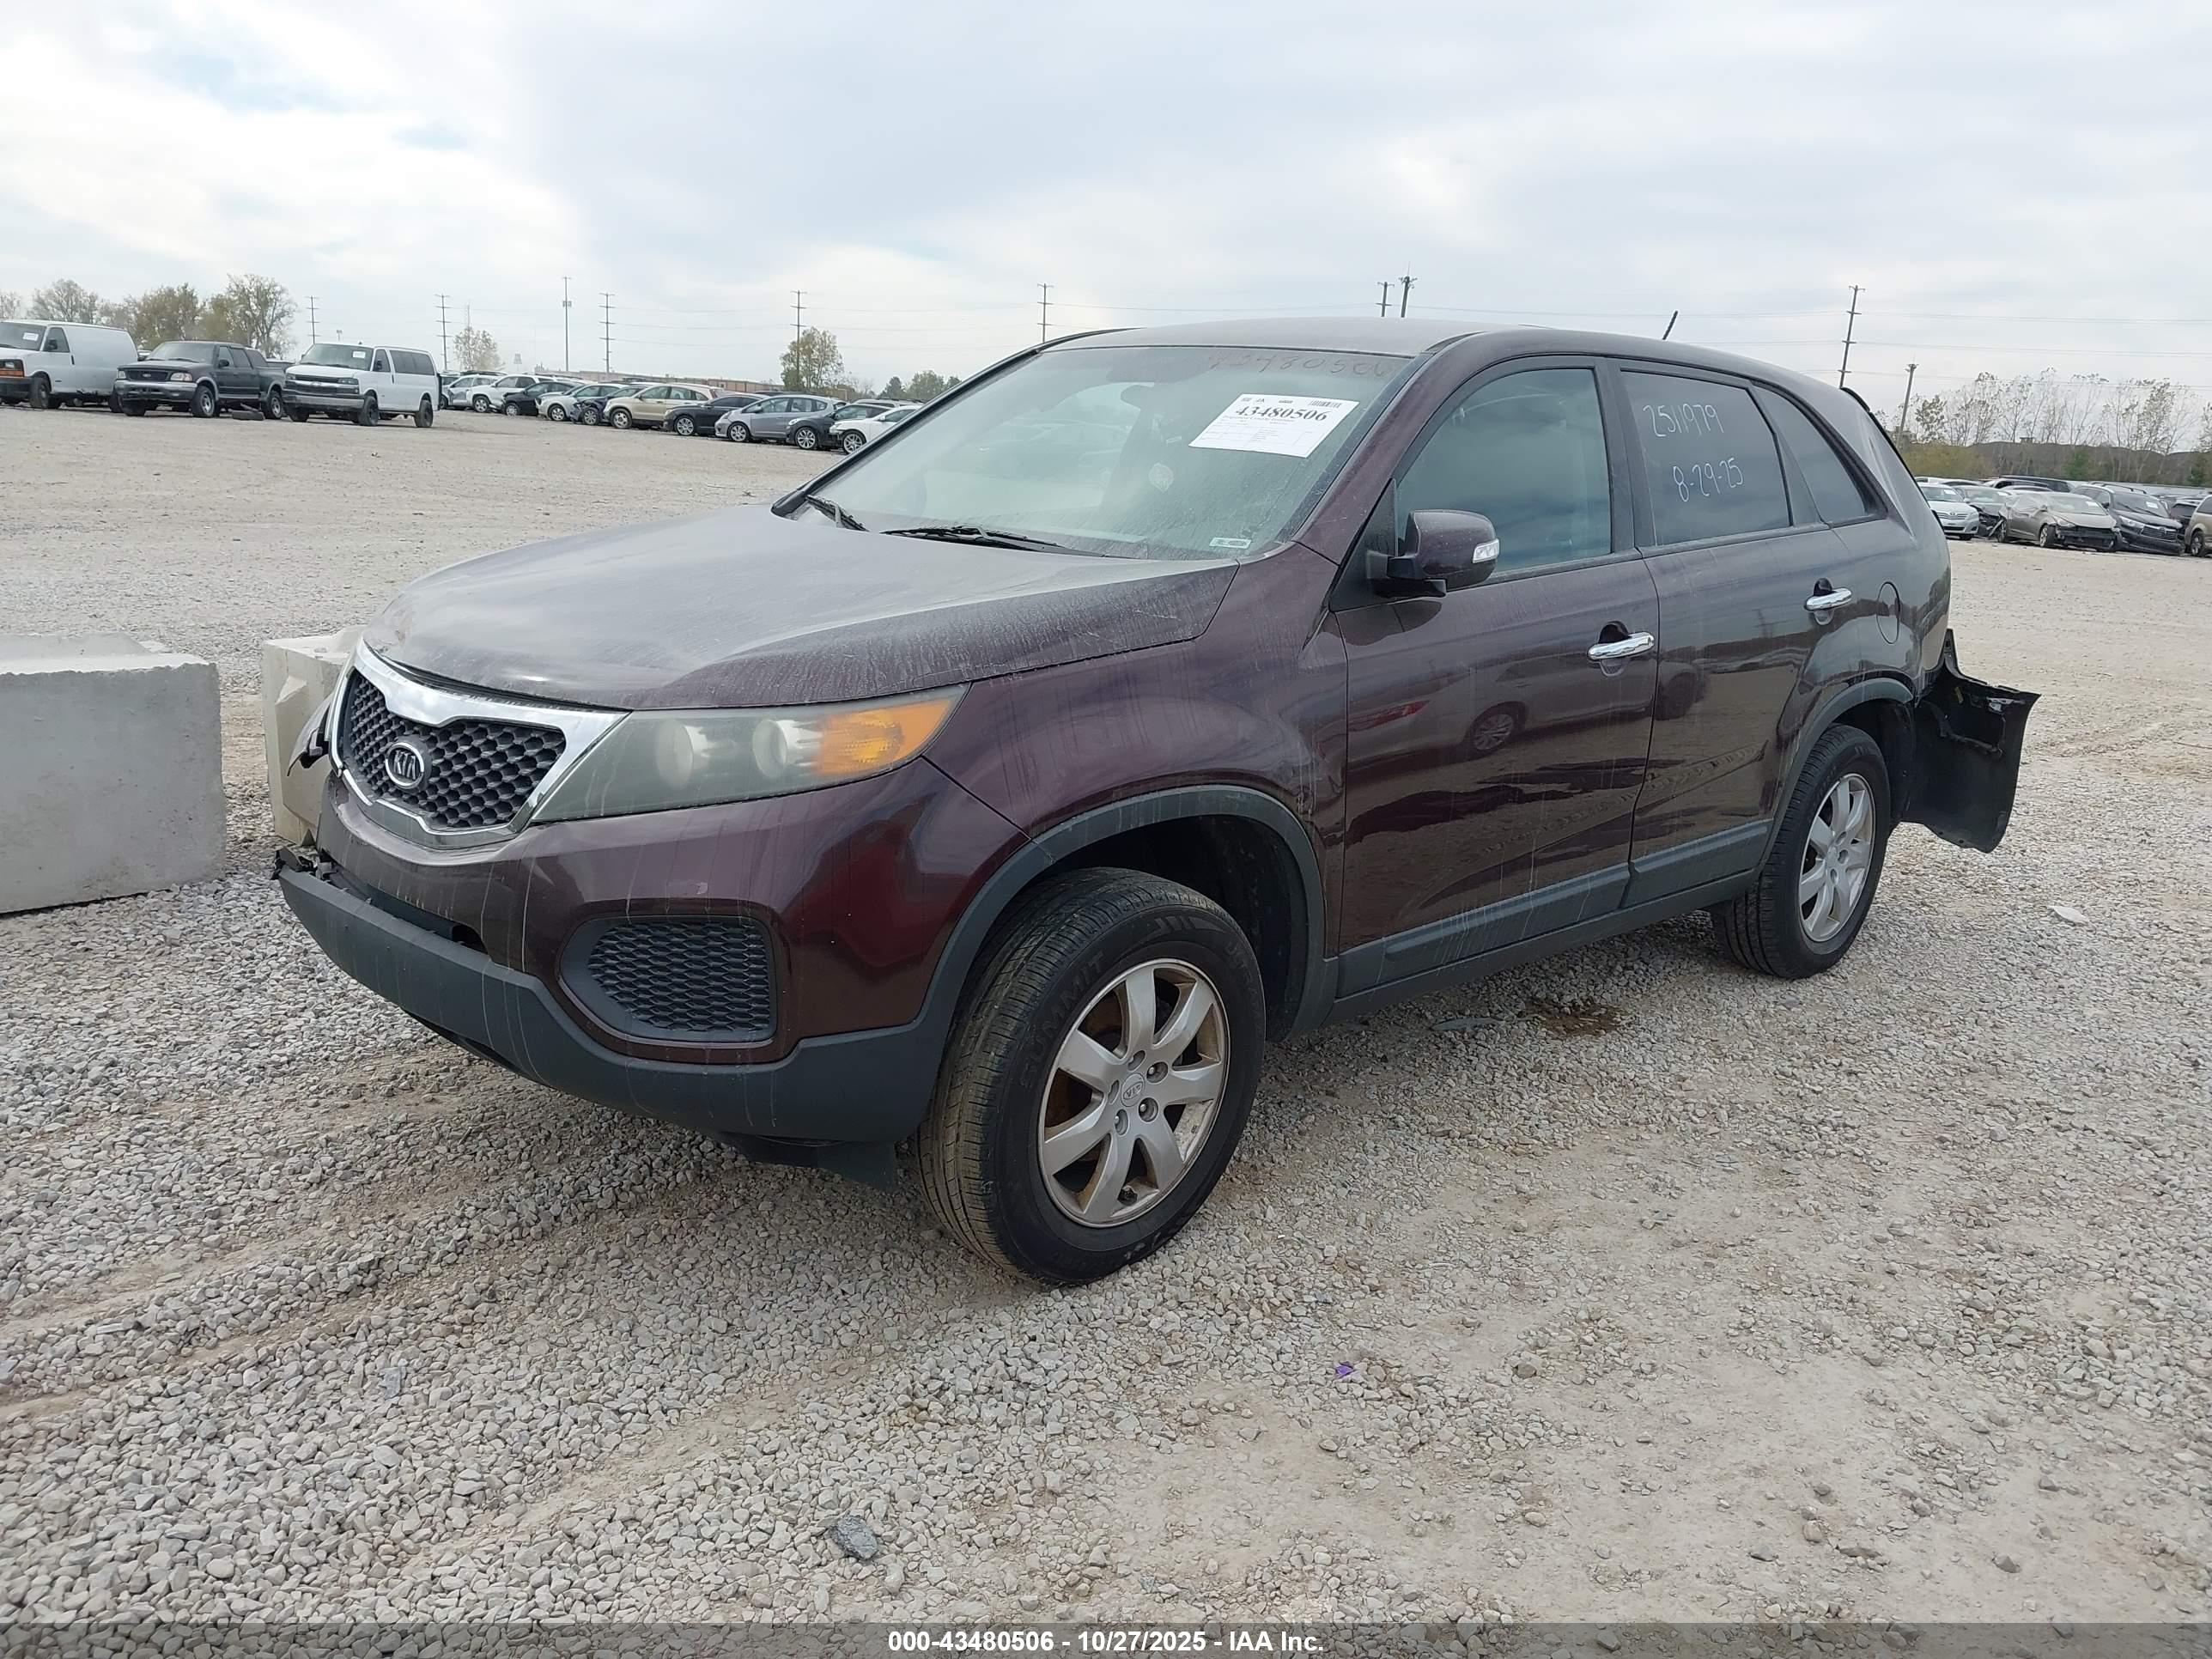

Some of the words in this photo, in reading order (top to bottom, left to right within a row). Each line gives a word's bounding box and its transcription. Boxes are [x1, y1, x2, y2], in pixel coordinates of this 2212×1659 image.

[1235, 405, 1332, 422] 43480506
[1642, 403, 1724, 438] 2511979
[1672, 456, 1744, 502] 8-29-25
